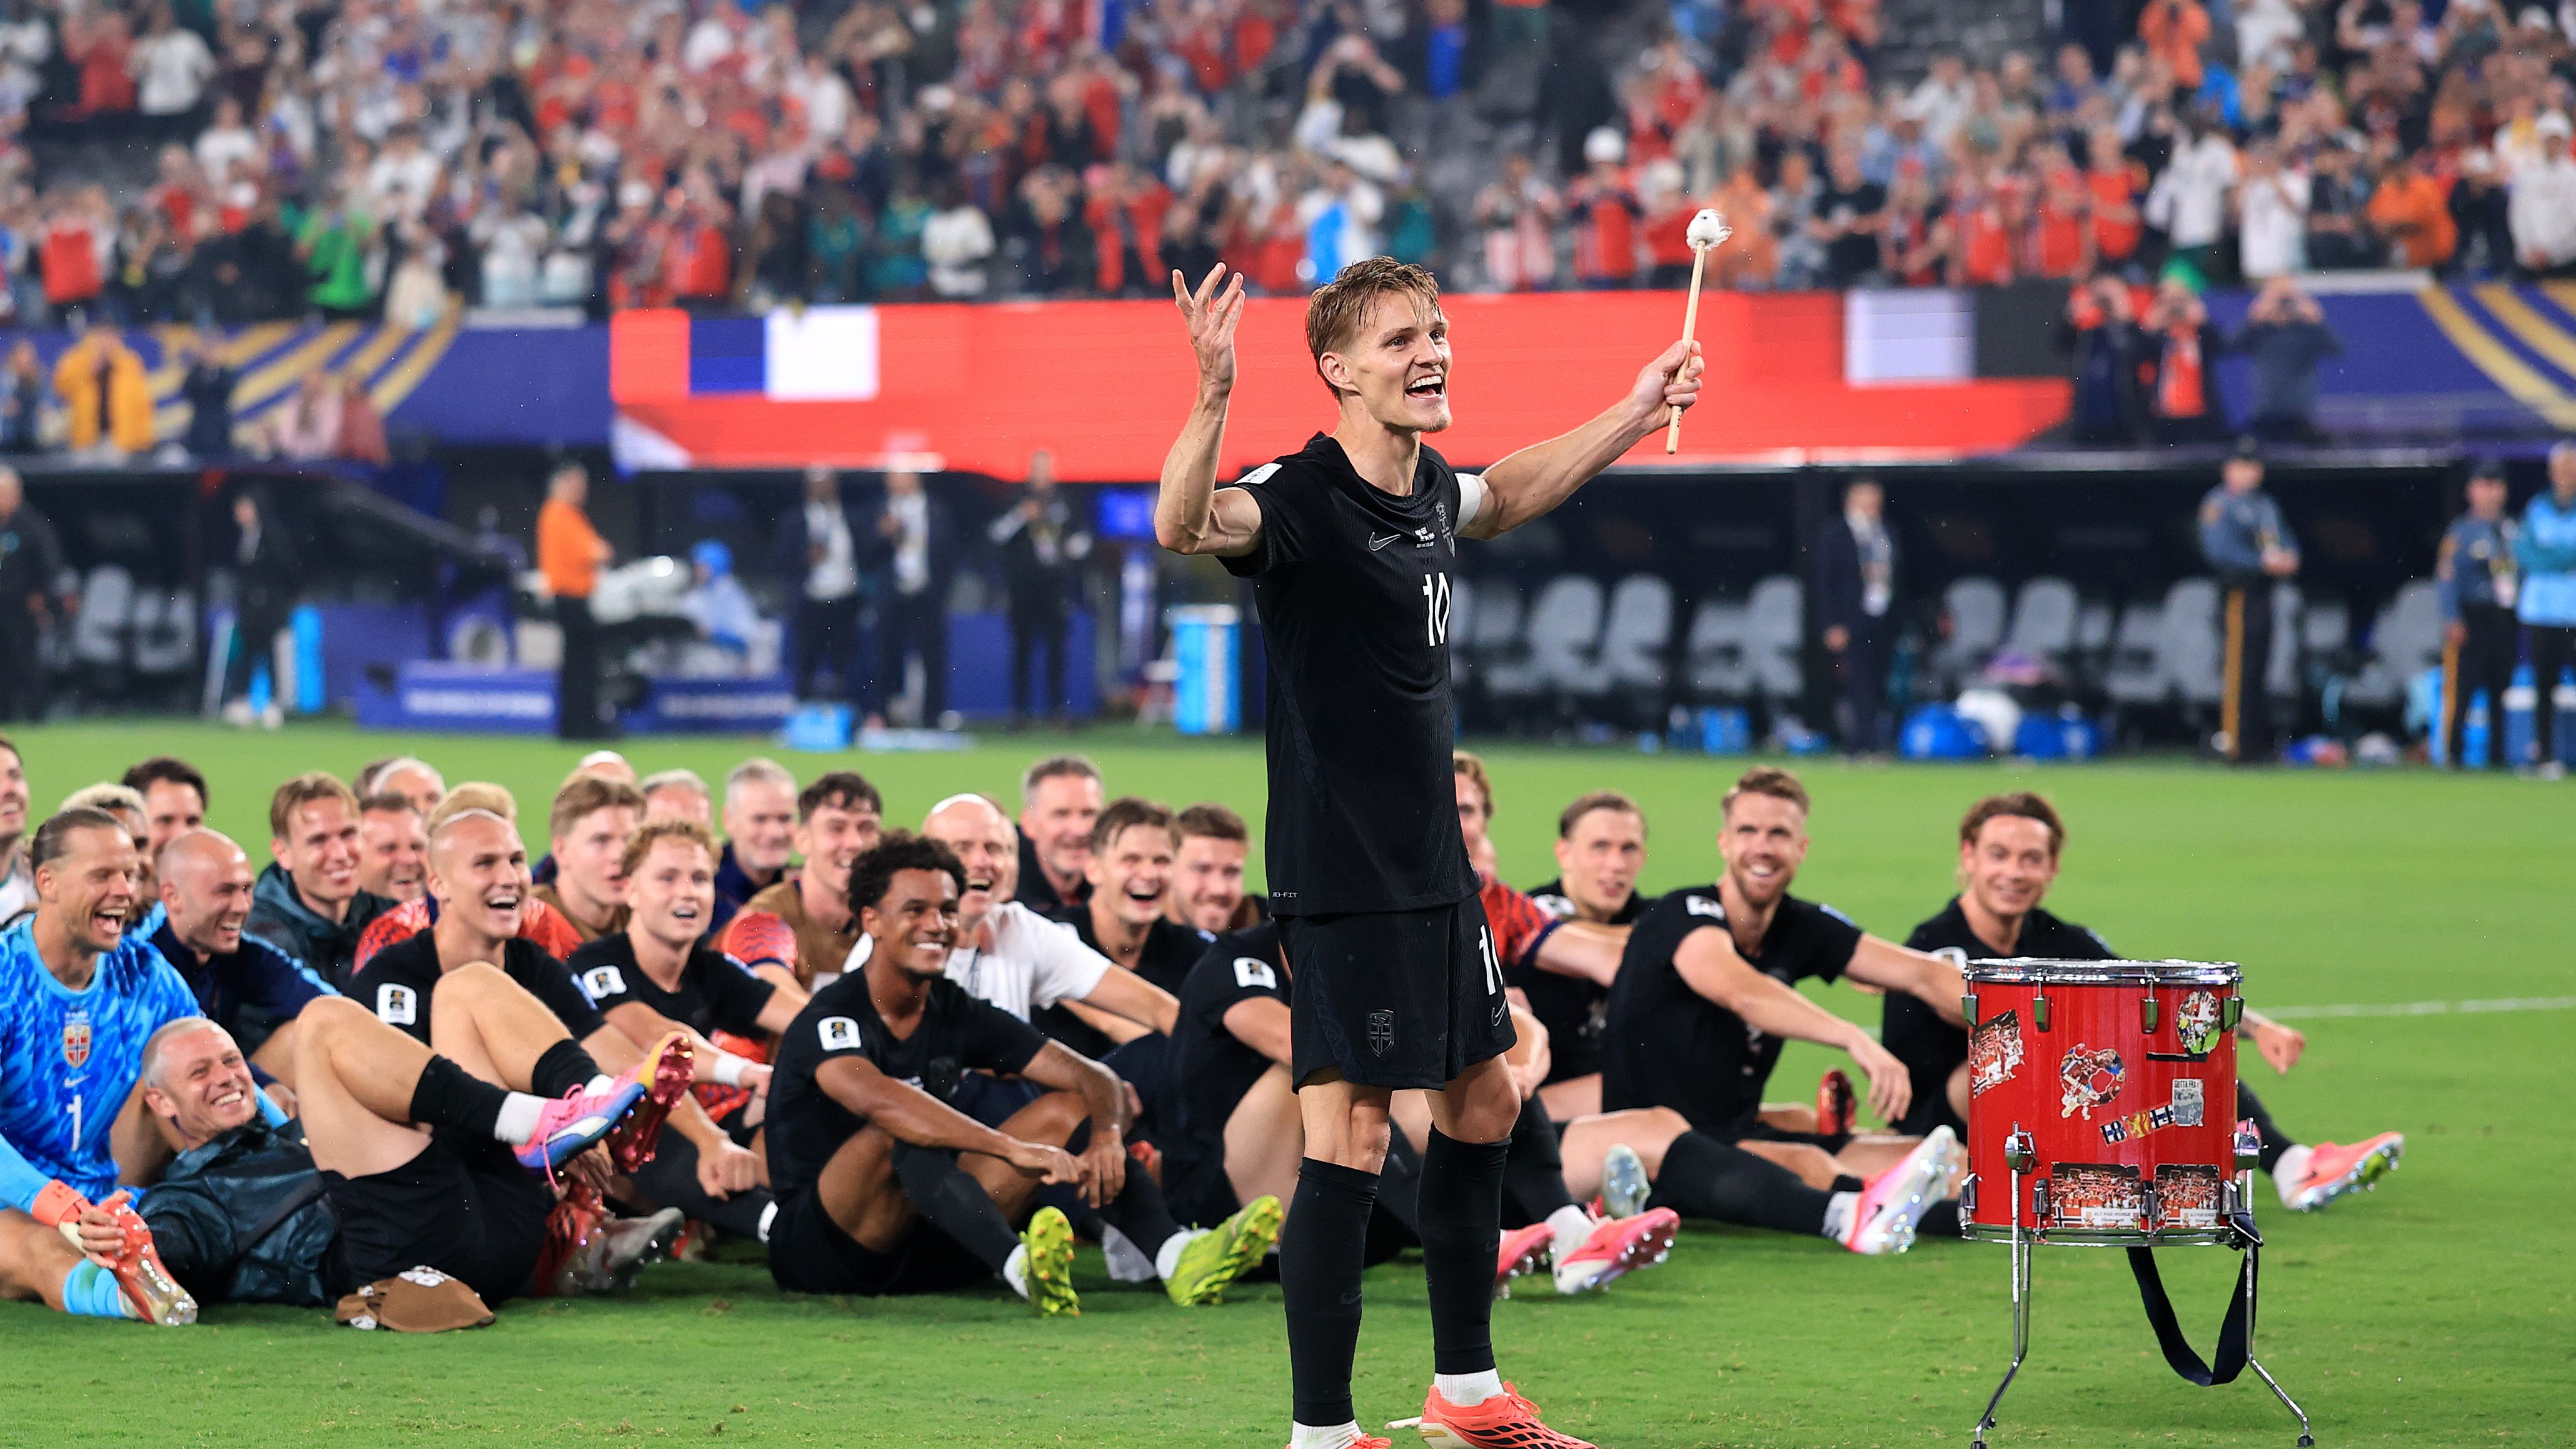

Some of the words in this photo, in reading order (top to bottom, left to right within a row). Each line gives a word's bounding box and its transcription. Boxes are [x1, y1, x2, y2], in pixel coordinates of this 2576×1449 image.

[1422, 572, 1450, 646] 10
[66, 1095, 82, 1152] 1
[2100, 1120, 2125, 1145] 18
